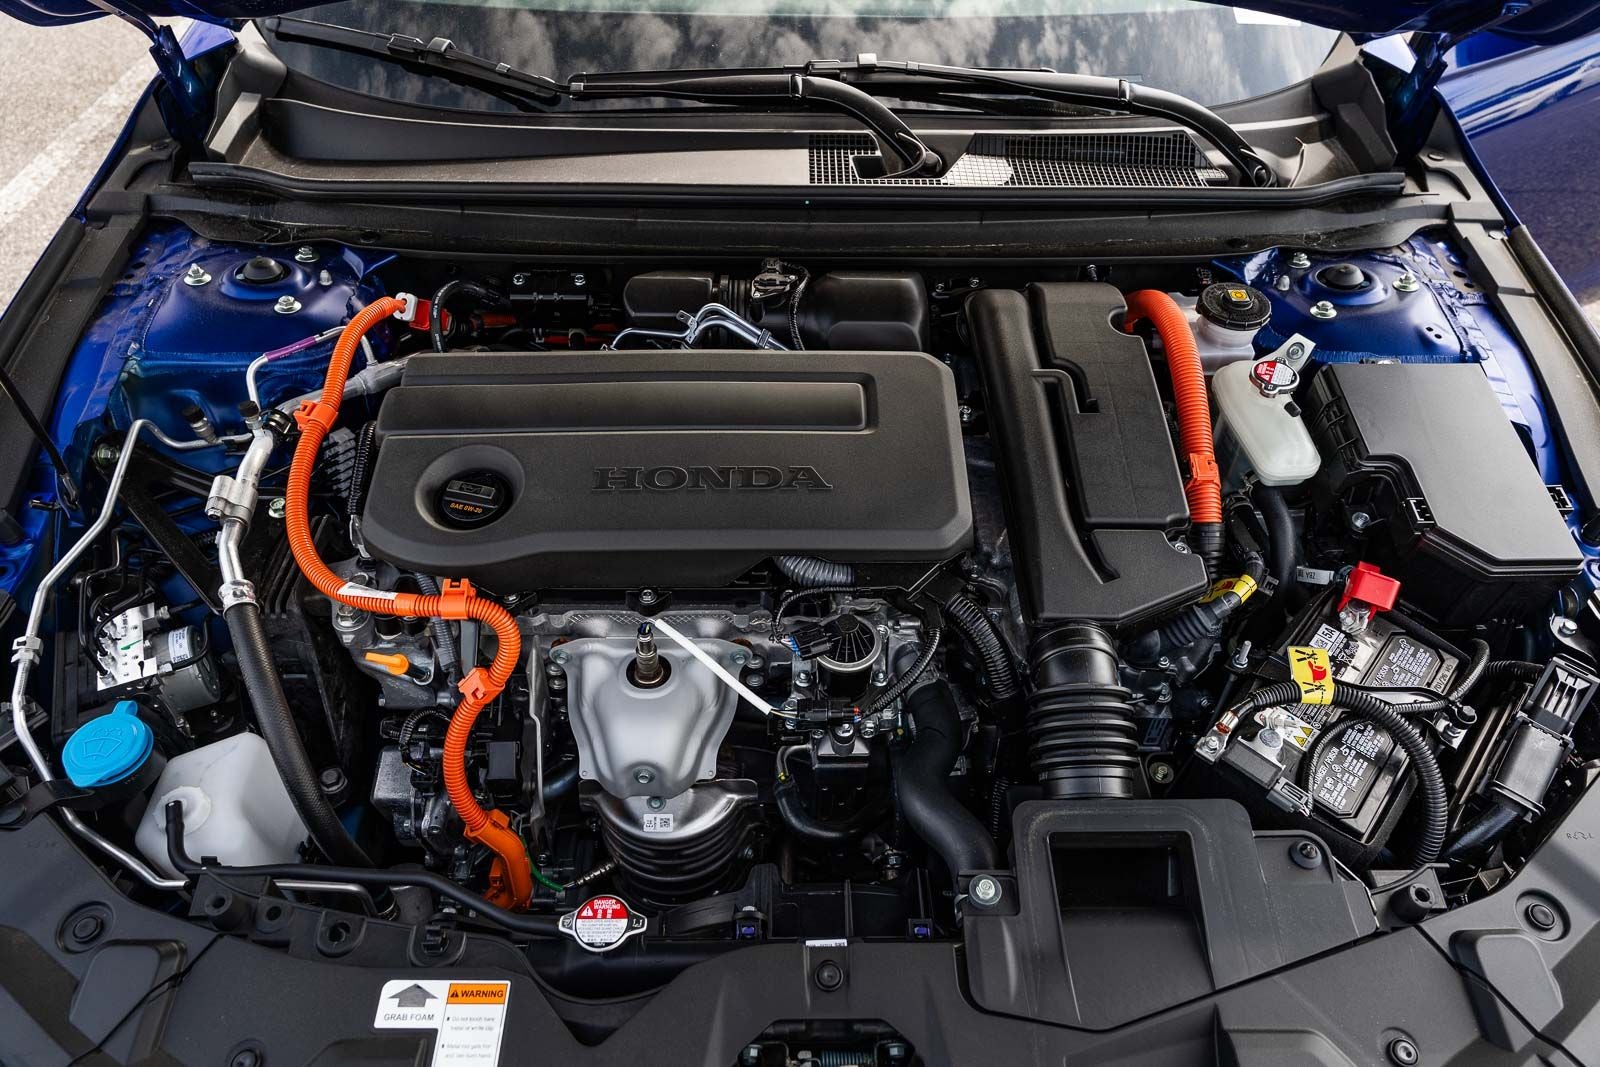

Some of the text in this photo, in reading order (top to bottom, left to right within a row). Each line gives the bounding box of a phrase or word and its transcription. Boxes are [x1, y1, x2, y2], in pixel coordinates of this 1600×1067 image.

[592, 465, 833, 491] HONDA
[450, 502, 464, 510] SAE
[1321, 627, 1336, 639] 5A
[460, 990, 504, 998] WARNING
[383, 1013, 435, 1021] GRAB FOAM
